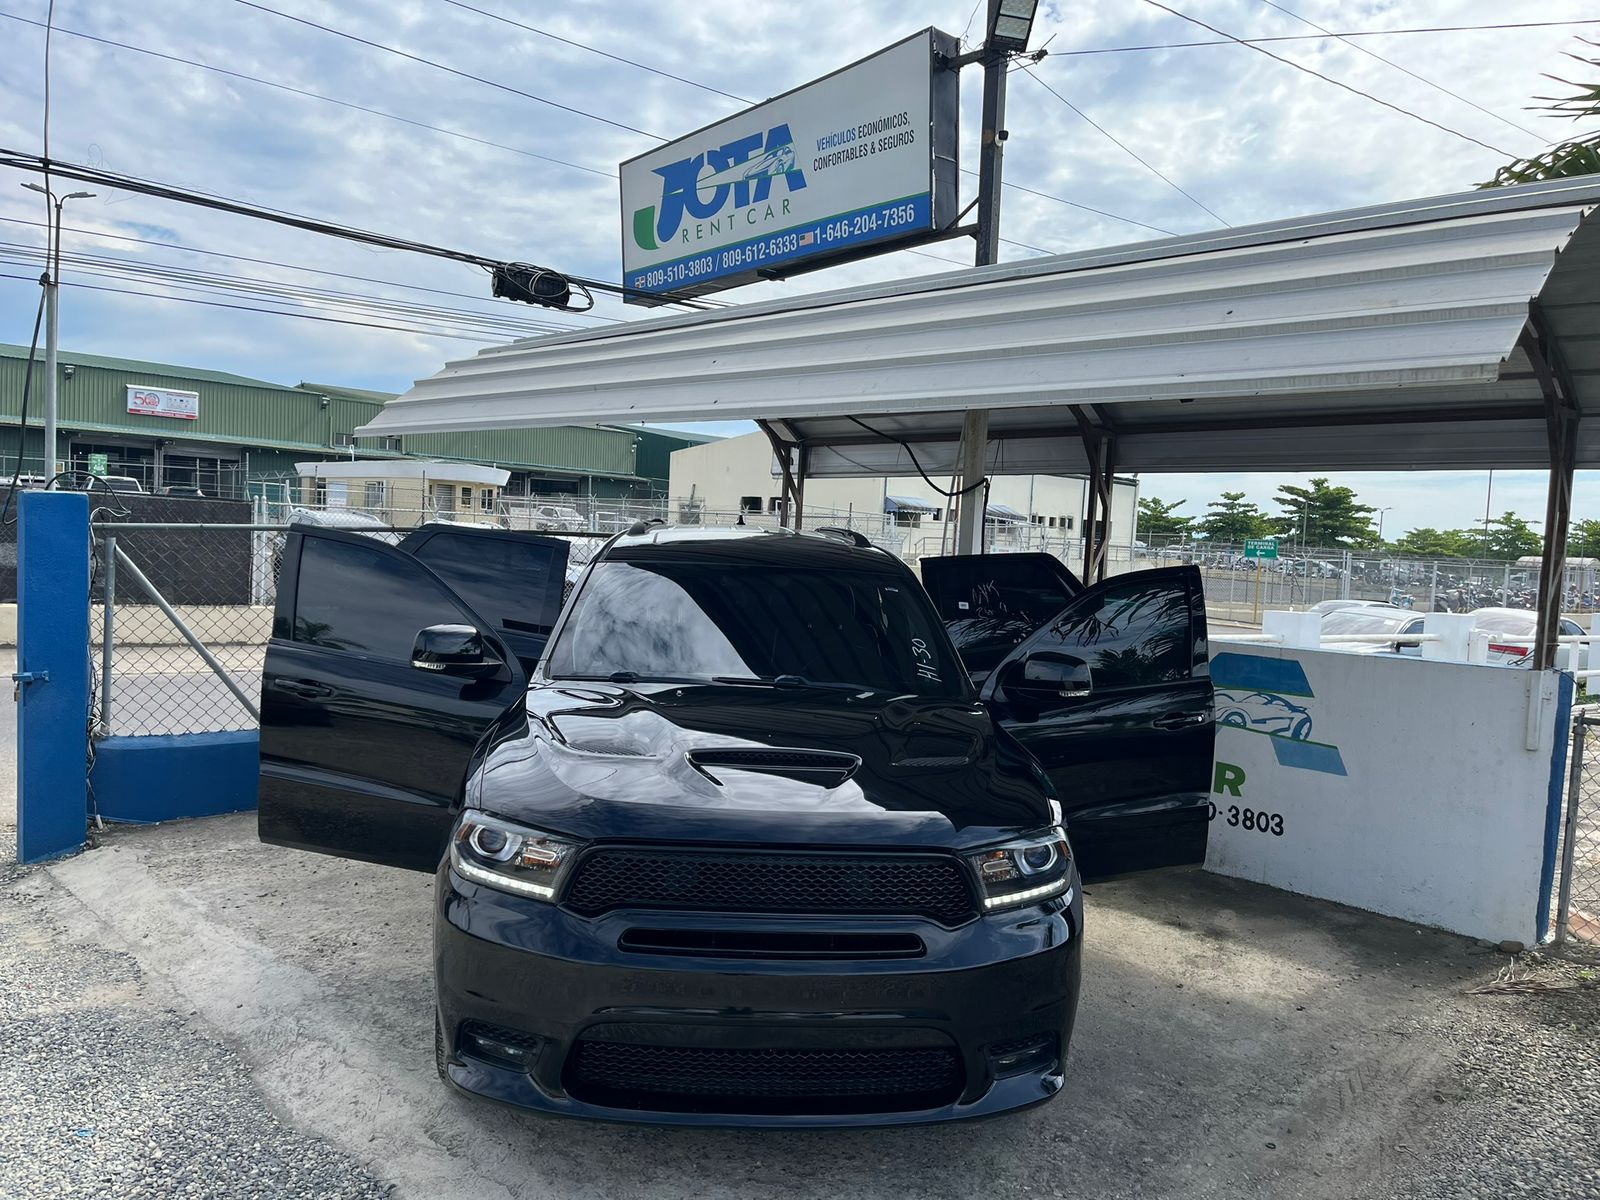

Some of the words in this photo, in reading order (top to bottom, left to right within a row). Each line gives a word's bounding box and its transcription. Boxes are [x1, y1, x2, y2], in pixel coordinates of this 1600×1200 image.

[813, 143, 868, 172] CONFORTABLES
[870, 141, 876, 154] &
[878, 130, 915, 152] SEGUROS
[816, 127, 857, 152] VEHÍCULOS
[858, 111, 911, 139] ECONÓMICOS,
[633, 123, 807, 250] JOTA
[682, 214, 736, 244] RENT
[746, 198, 791, 225] CAR
[646, 256, 713, 288] 809-510-3803
[722, 233, 798, 268] 809-612-6333
[814, 203, 916, 244] 1-646-204-7356
